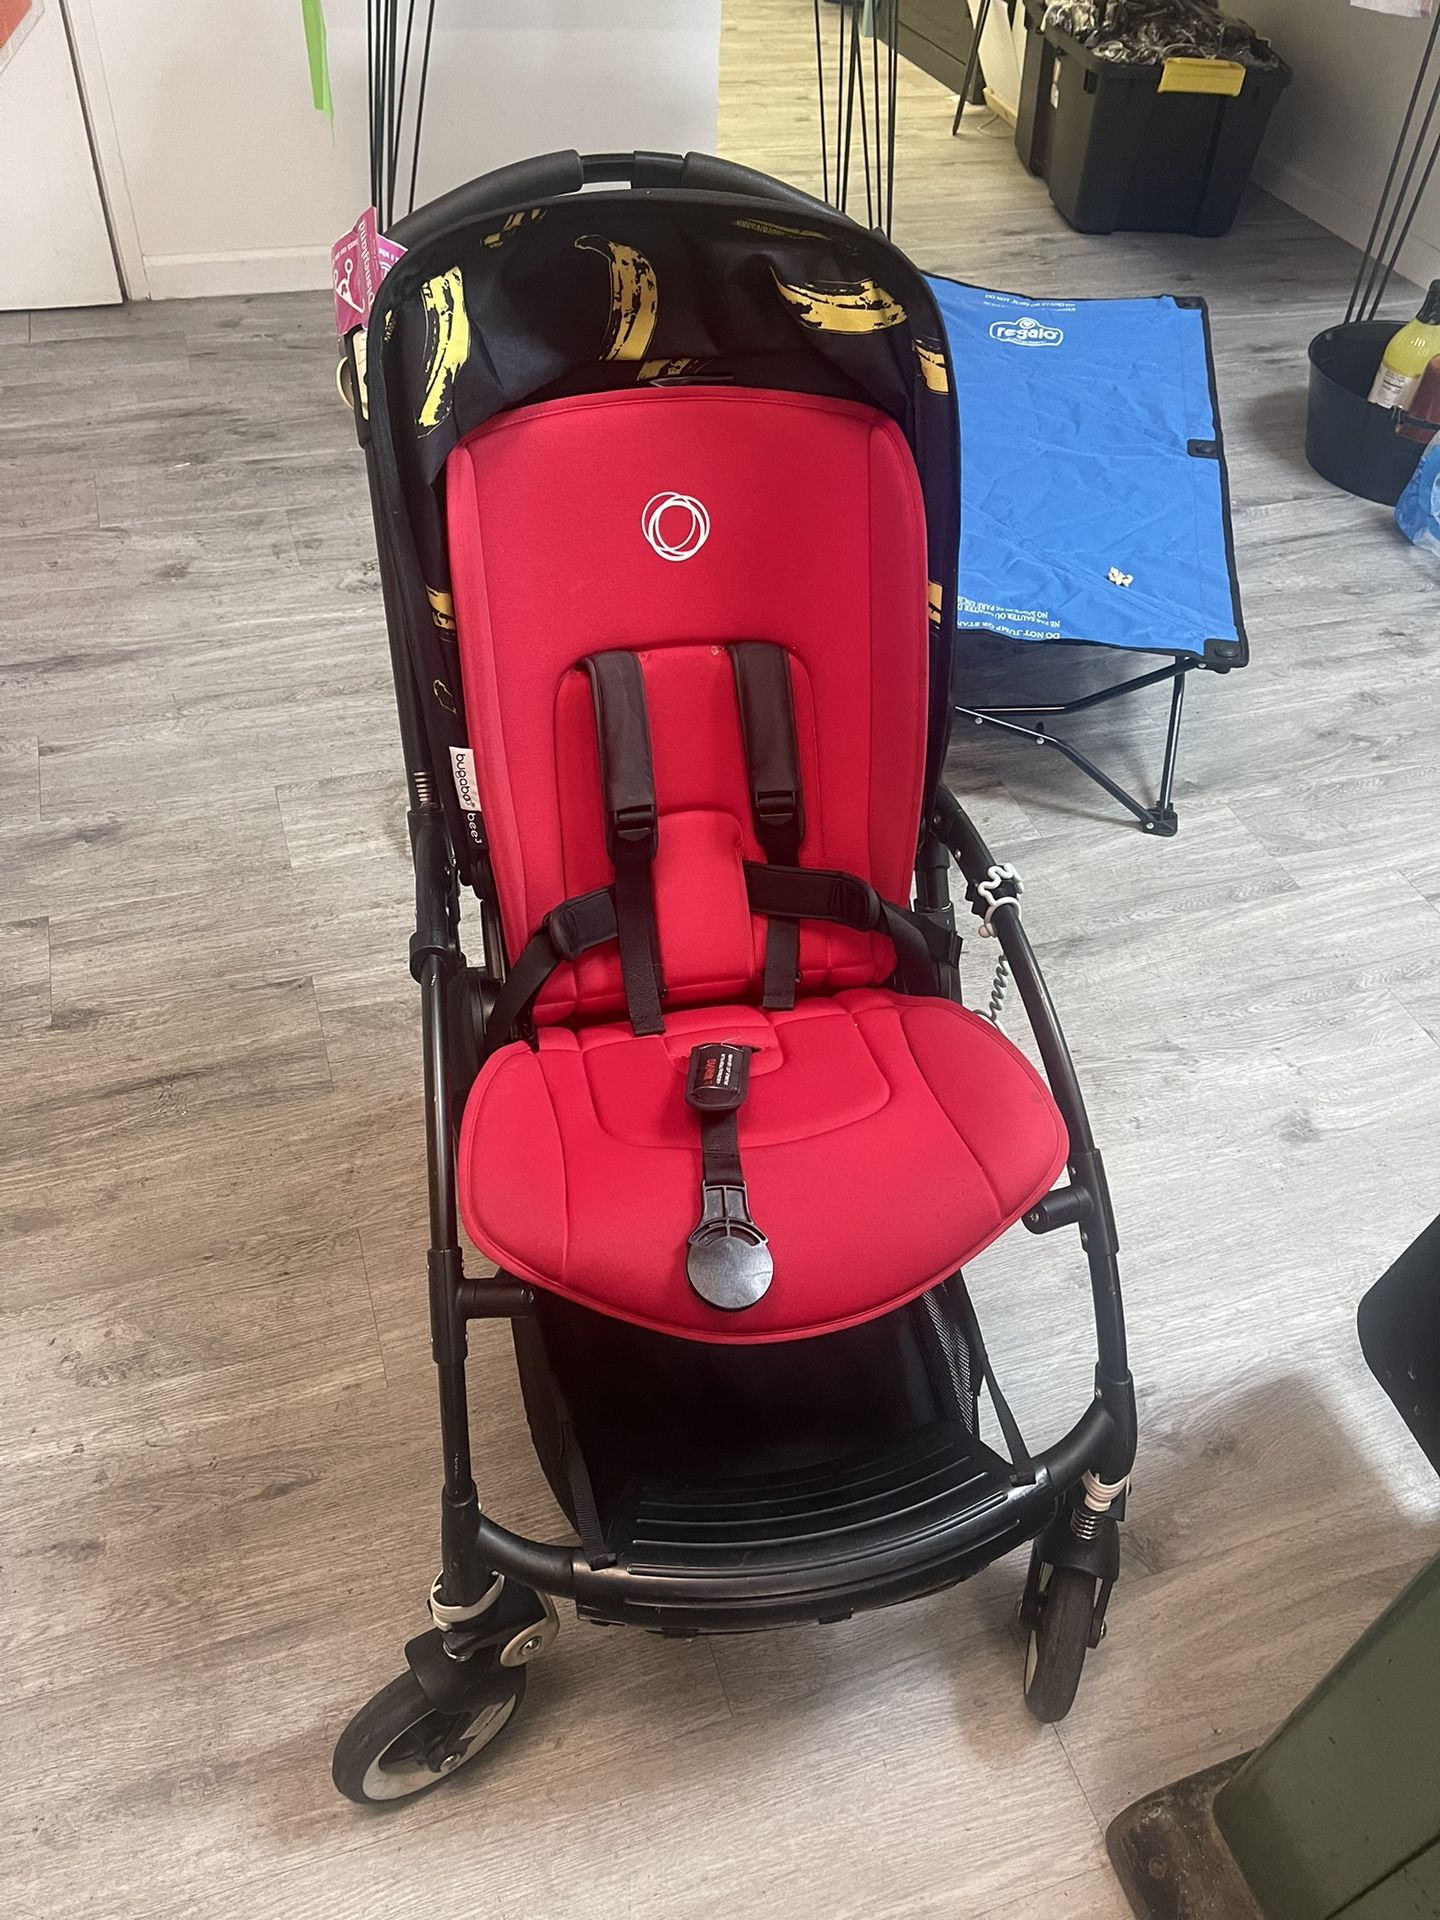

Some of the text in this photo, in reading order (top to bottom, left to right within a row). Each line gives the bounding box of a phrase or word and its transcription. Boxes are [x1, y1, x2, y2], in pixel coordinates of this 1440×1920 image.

[997, 327, 1057, 340] regalo
[957, 620, 980, 628] STAN
[995, 625, 1023, 636] JUMP
[1023, 629, 1044, 639] NOT
[1045, 632, 1060, 640] DO
